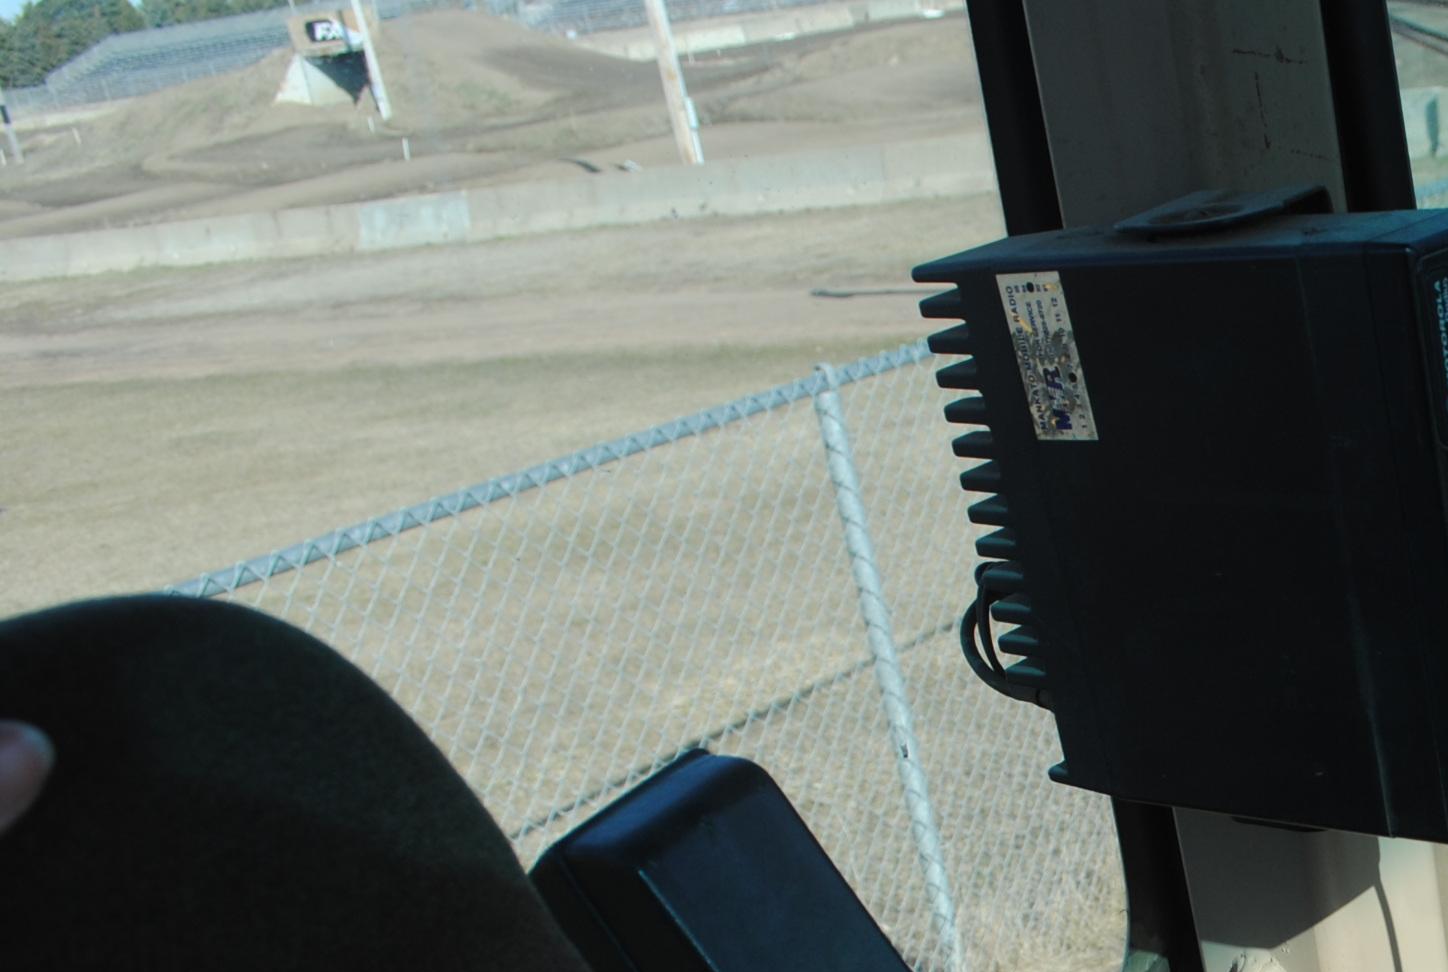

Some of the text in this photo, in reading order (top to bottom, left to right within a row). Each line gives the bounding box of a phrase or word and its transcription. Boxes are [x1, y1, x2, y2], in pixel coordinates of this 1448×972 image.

[1006, 286, 1020, 323] RADIO
[1015, 327, 1032, 371] MOBILE
[1028, 375, 1048, 431] MANKATO
